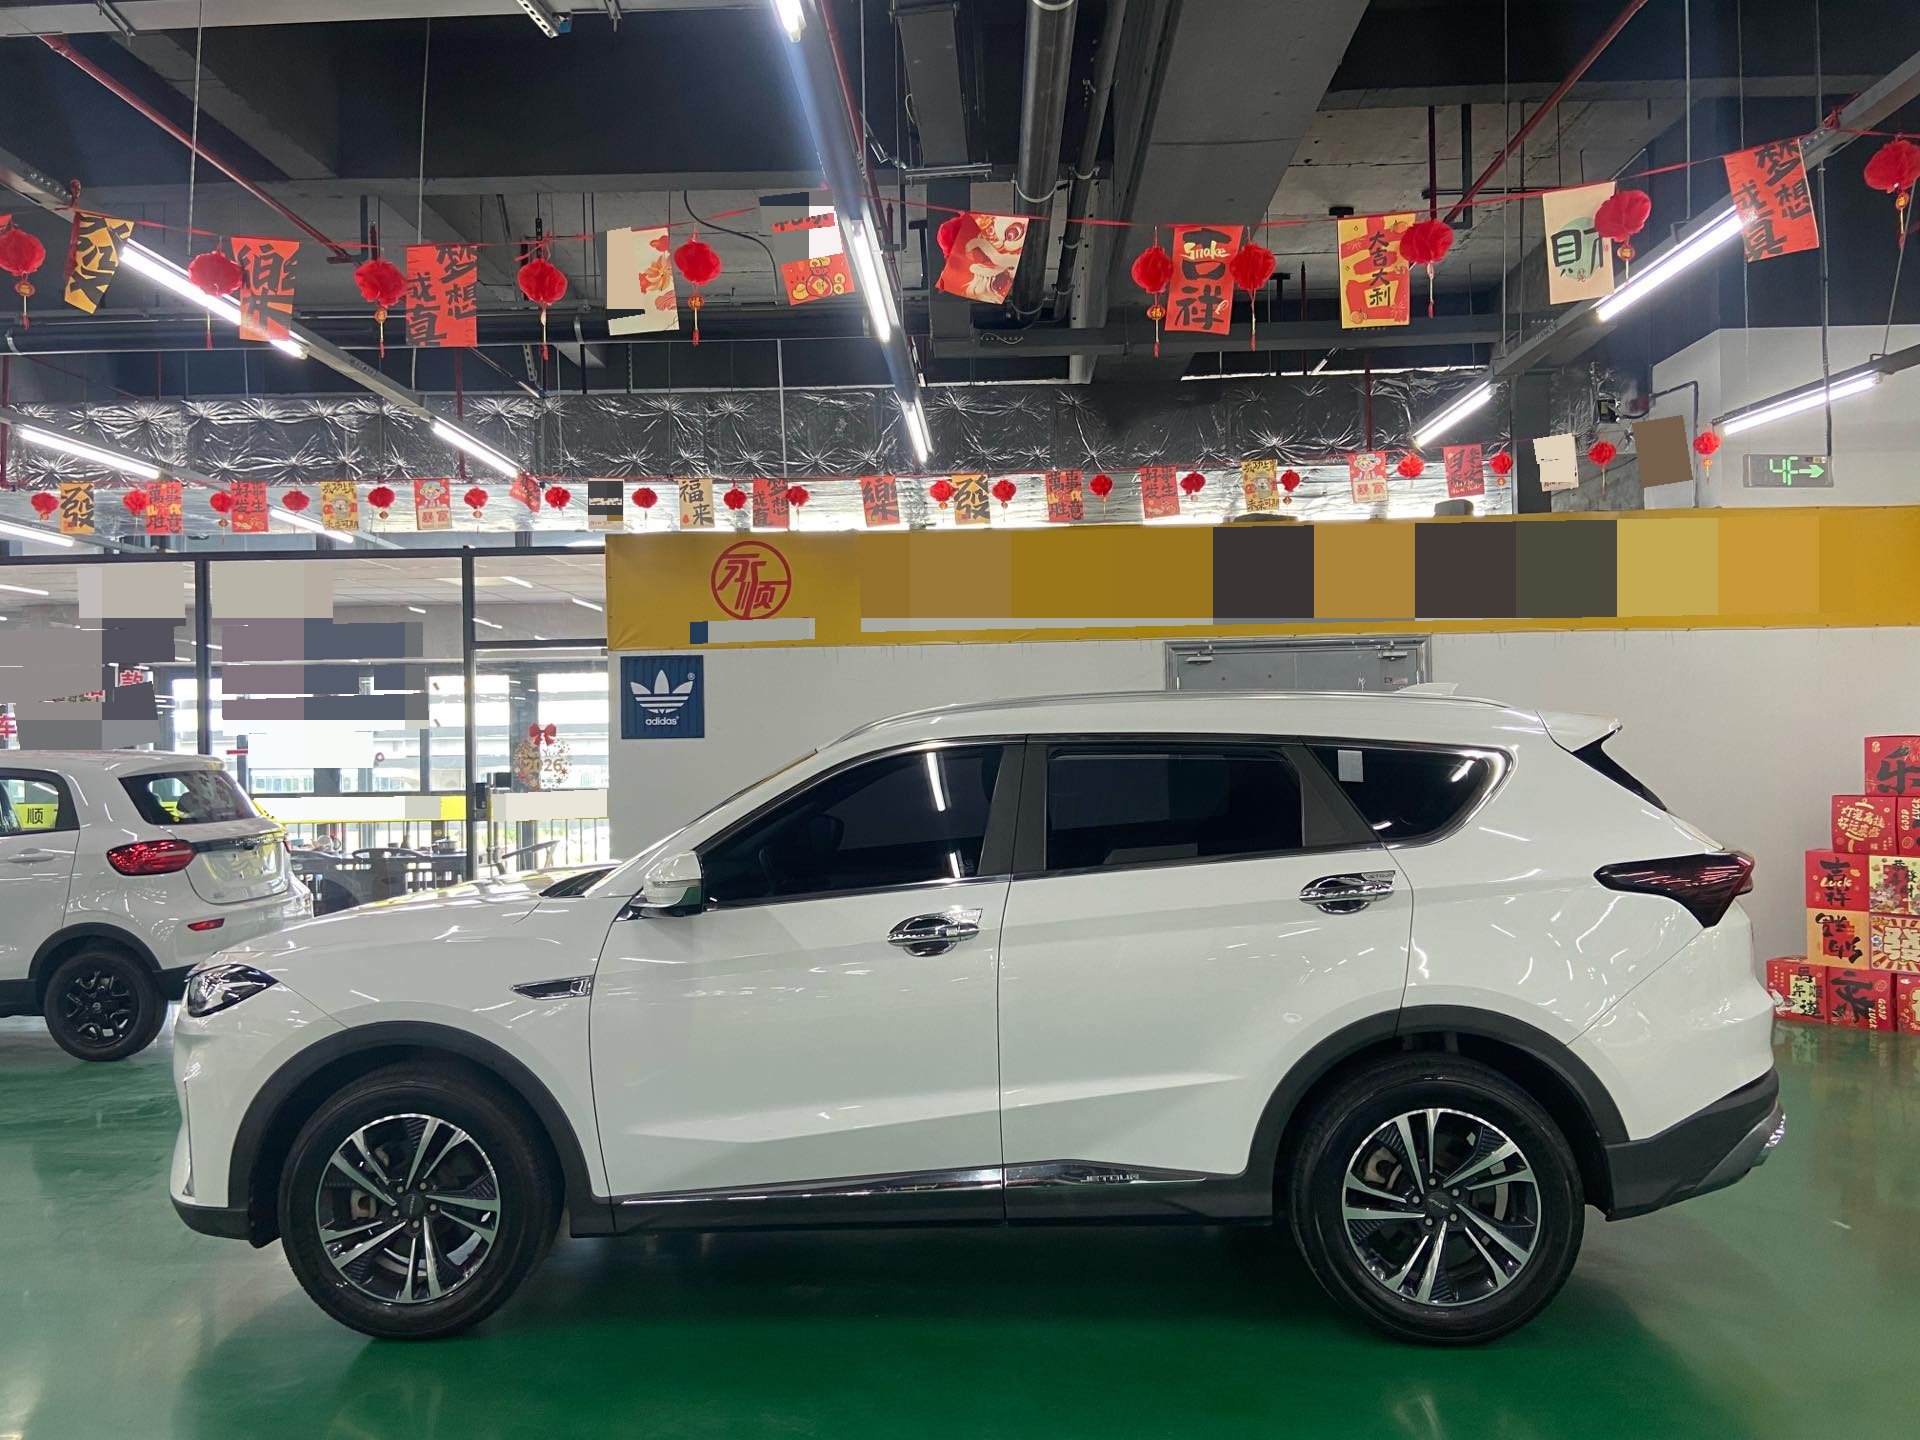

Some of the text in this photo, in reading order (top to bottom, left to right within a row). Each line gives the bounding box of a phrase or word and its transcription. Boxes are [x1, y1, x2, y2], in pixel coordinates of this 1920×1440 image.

[1181, 240, 1230, 260] Snake
[1367, 230, 1391, 307] 大吉大利
[680, 479, 714, 526] 福来
[645, 717, 677, 726] adidas
[526, 758, 562, 772] 2026
[27, 807, 44, 824] 顺
[1901, 808, 1910, 831] GOOD
[1820, 876, 1853, 888] Luck
